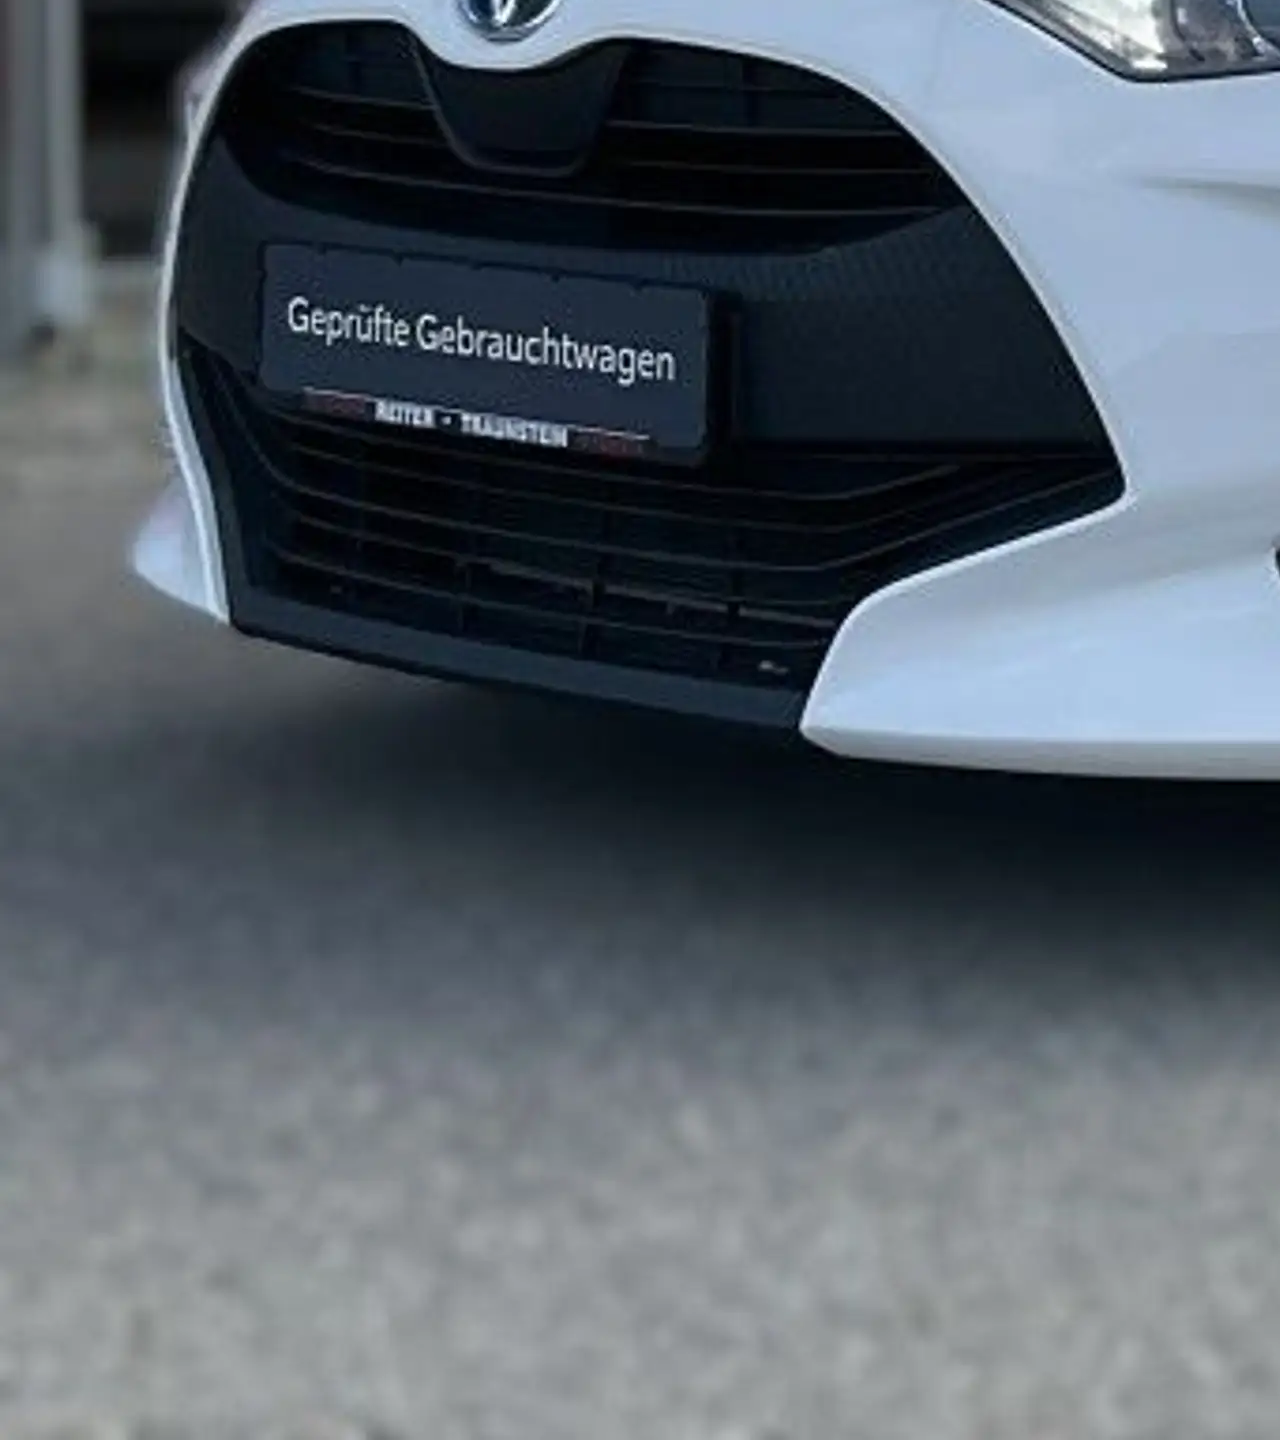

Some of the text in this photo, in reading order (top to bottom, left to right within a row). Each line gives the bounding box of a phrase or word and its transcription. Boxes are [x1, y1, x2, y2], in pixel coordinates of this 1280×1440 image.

[287, 295, 676, 387] Geprüfte Gebrauchtwagen
[375, 398, 436, 429] REITER
[461, 410, 569, 449] TRAUNSTEIN
